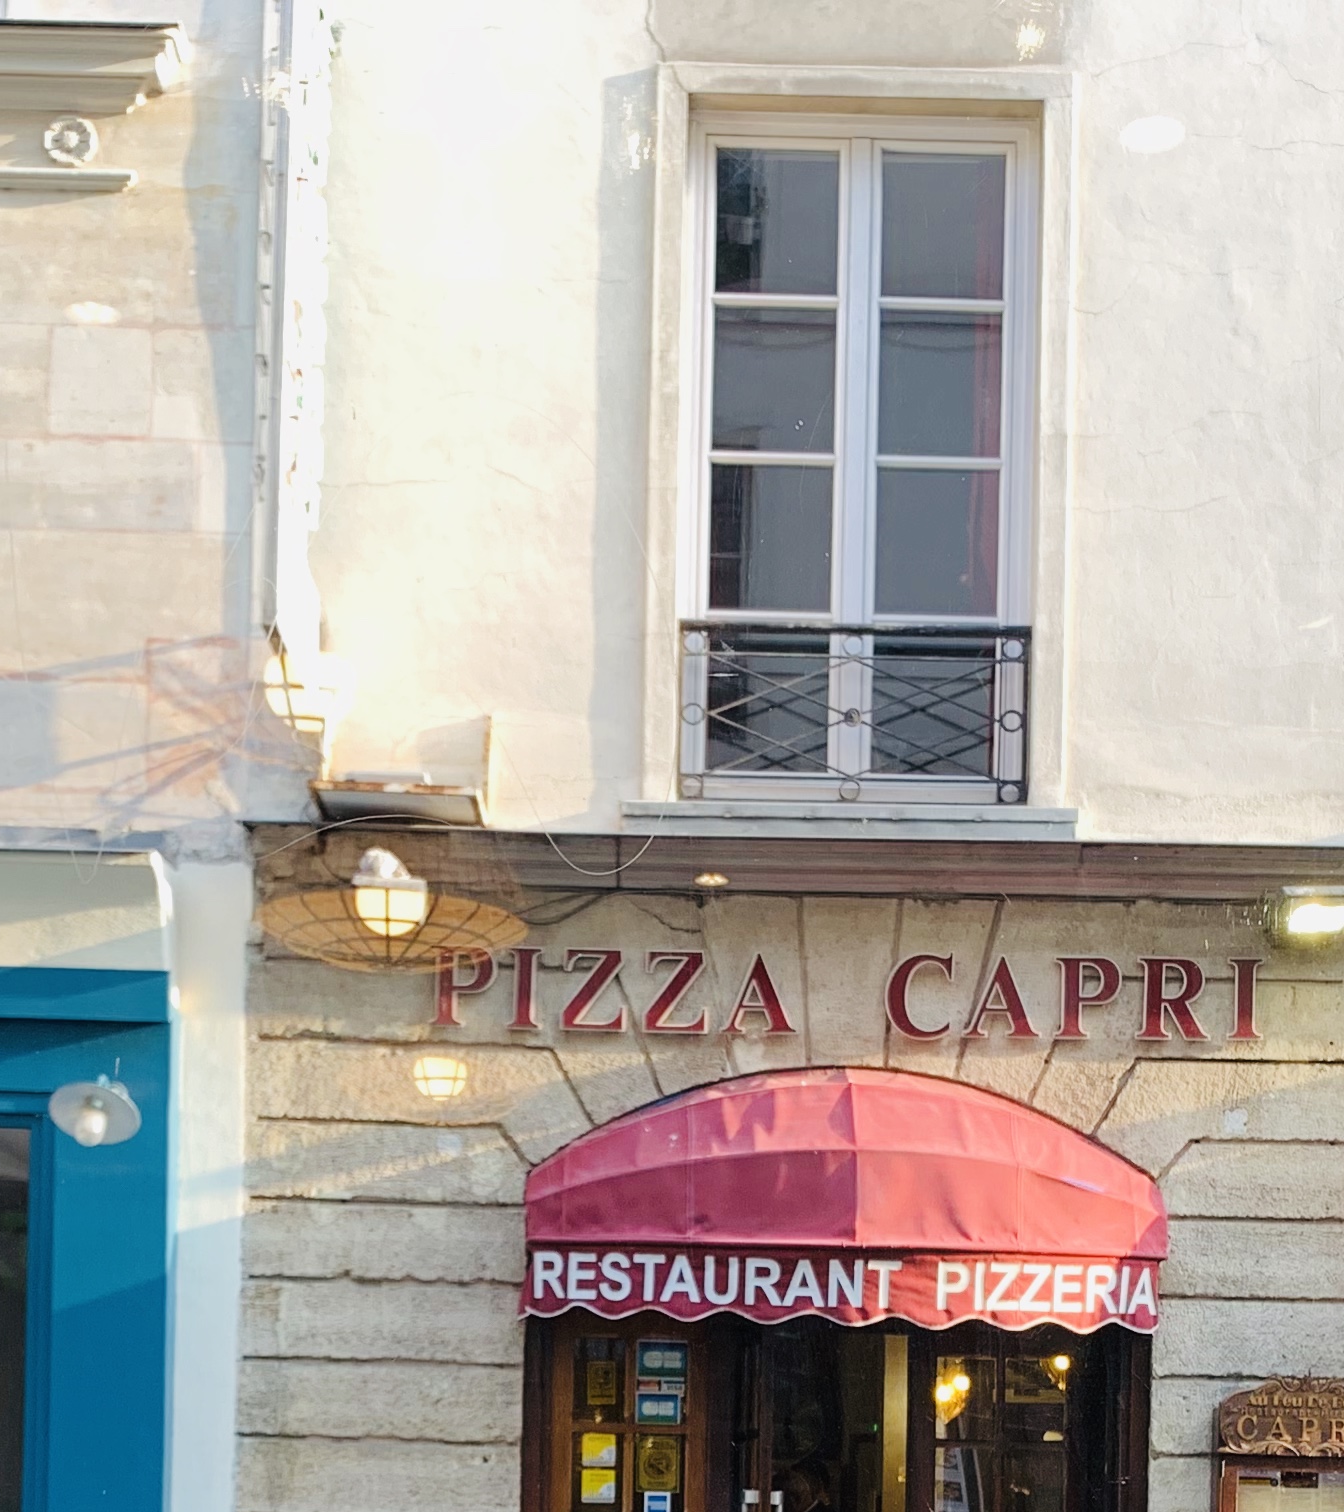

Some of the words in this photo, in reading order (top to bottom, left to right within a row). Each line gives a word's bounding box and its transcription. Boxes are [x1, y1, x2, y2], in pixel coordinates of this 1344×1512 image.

[428, 945, 797, 1035] PIZZA
[885, 952, 1265, 1043] CAPRI
[530, 1250, 904, 1309] RESTAURANT
[936, 1259, 1157, 1317] PIZZERIA
